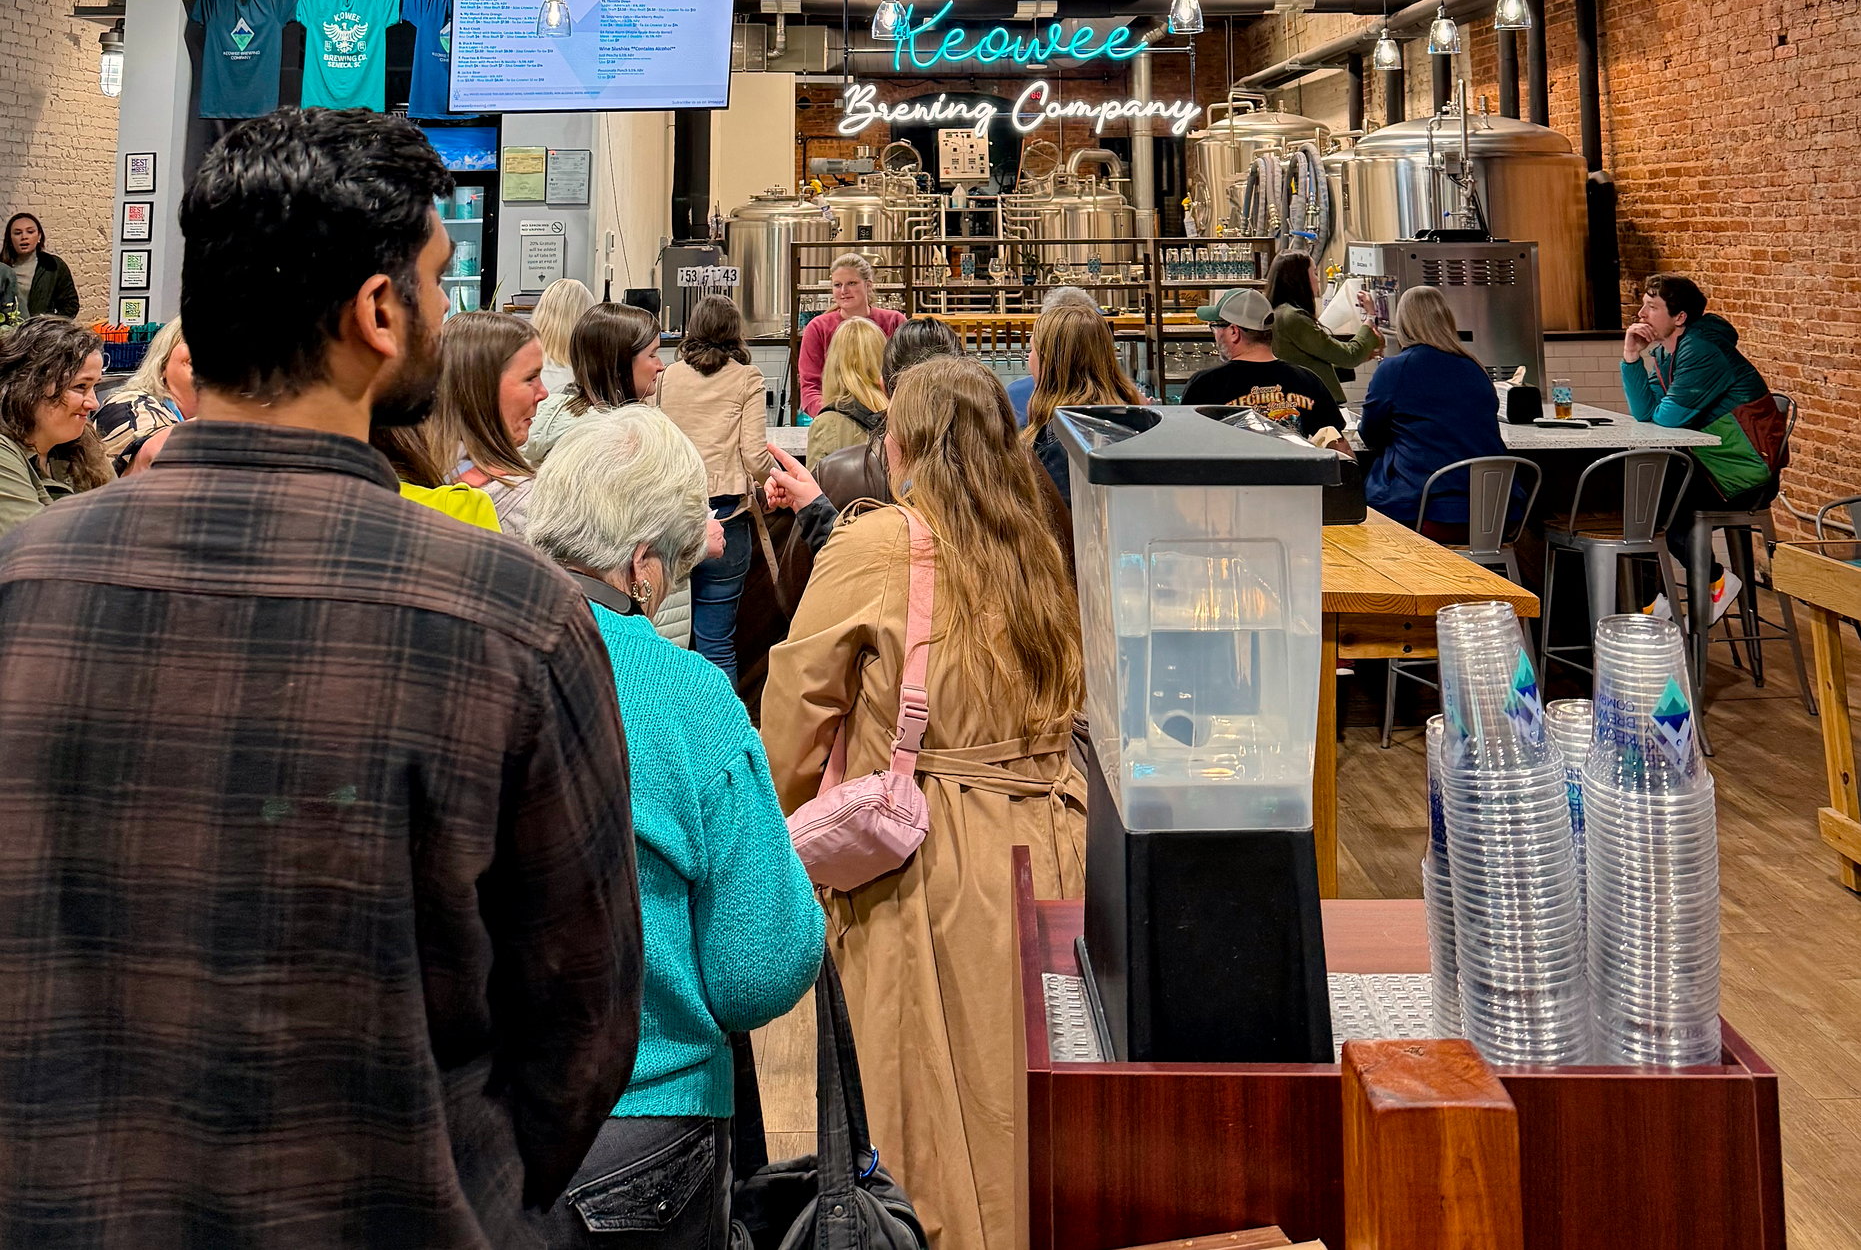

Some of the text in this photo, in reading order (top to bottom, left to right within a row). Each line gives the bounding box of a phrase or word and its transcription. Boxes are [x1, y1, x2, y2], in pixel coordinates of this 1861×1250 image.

[894, 0, 1149, 71] Keowee
[323, 54, 357, 62] BREWING
[838, 80, 1203, 138] Brewing Company
[131, 158, 149, 168] BEST
[685, 269, 698, 283] 53
[723, 269, 738, 282] 43
[1286, 392, 1315, 411] CITY
[1598, 709, 1636, 730] BREW
